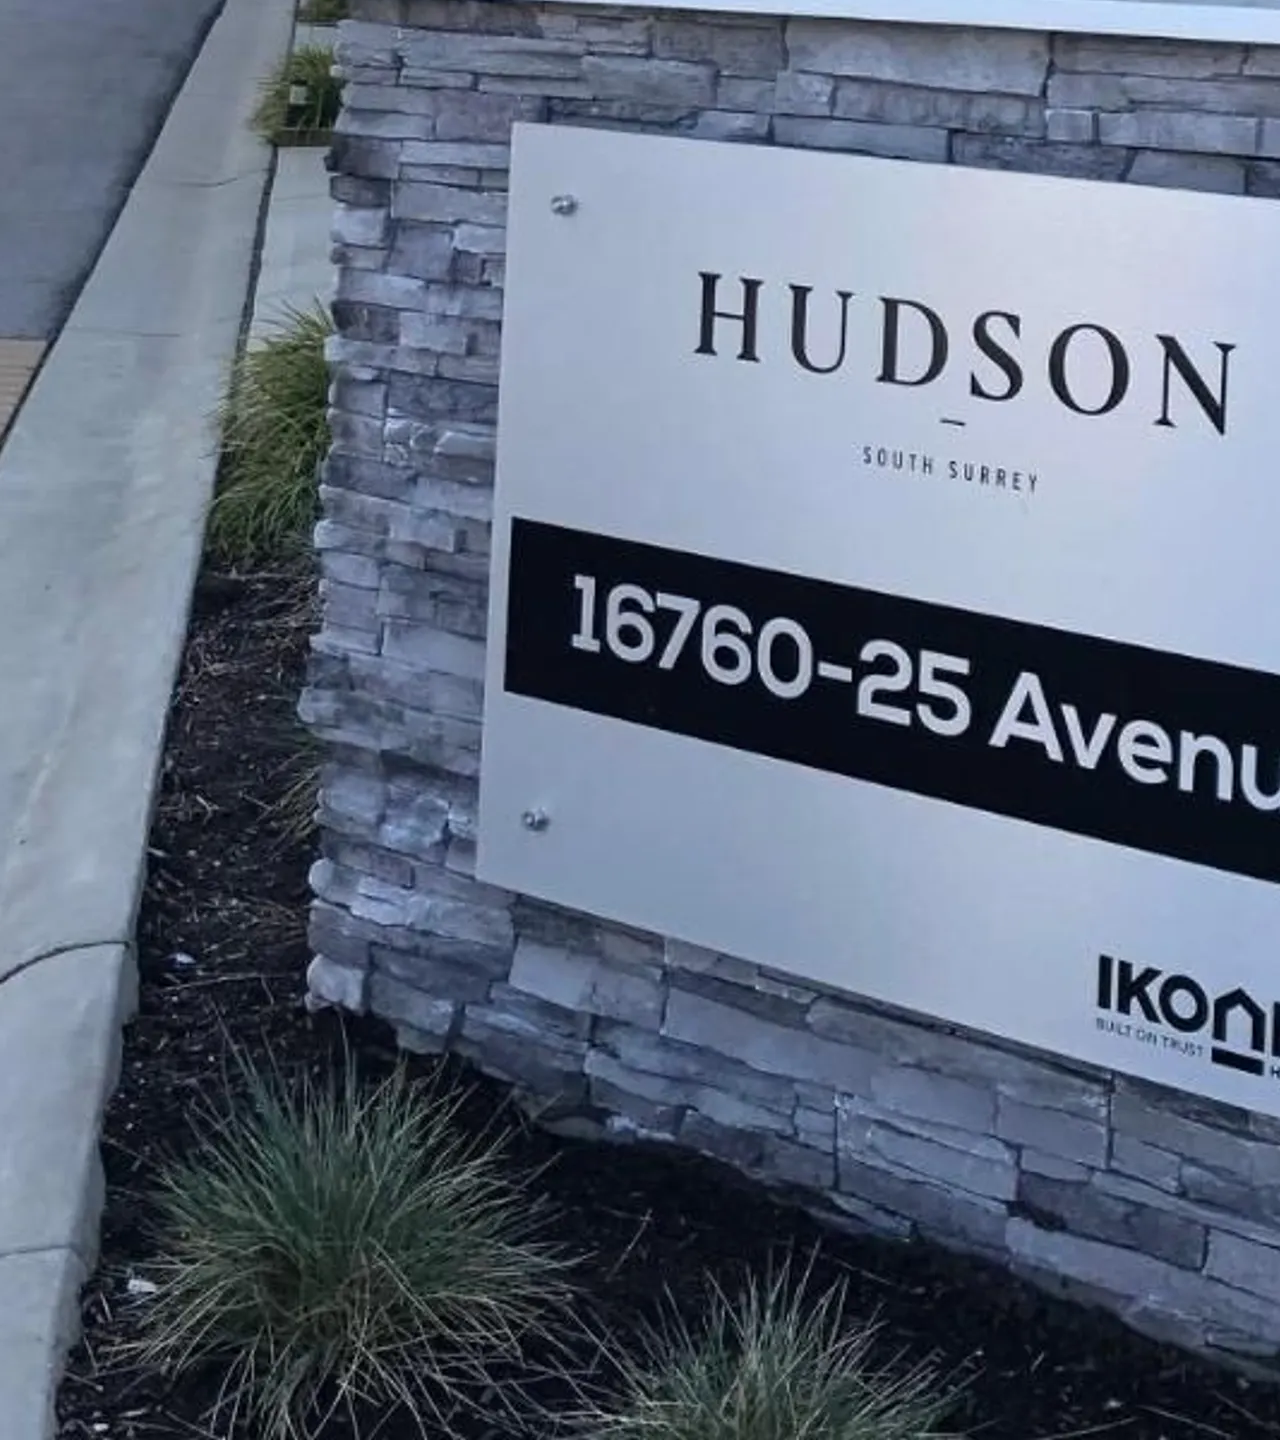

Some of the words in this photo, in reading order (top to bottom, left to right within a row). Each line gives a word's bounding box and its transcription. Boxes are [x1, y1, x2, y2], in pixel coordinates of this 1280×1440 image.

[693, 270, 1237, 436] HUDSON
[862, 446, 933, 476] SOUTH
[949, 460, 1038, 492] SURREY
[570, 573, 973, 738] 16760-25
[1095, 1017, 1133, 1036] BUILT
[1136, 1028, 1158, 1045] ON
[1161, 1035, 1203, 1057] TRUST
